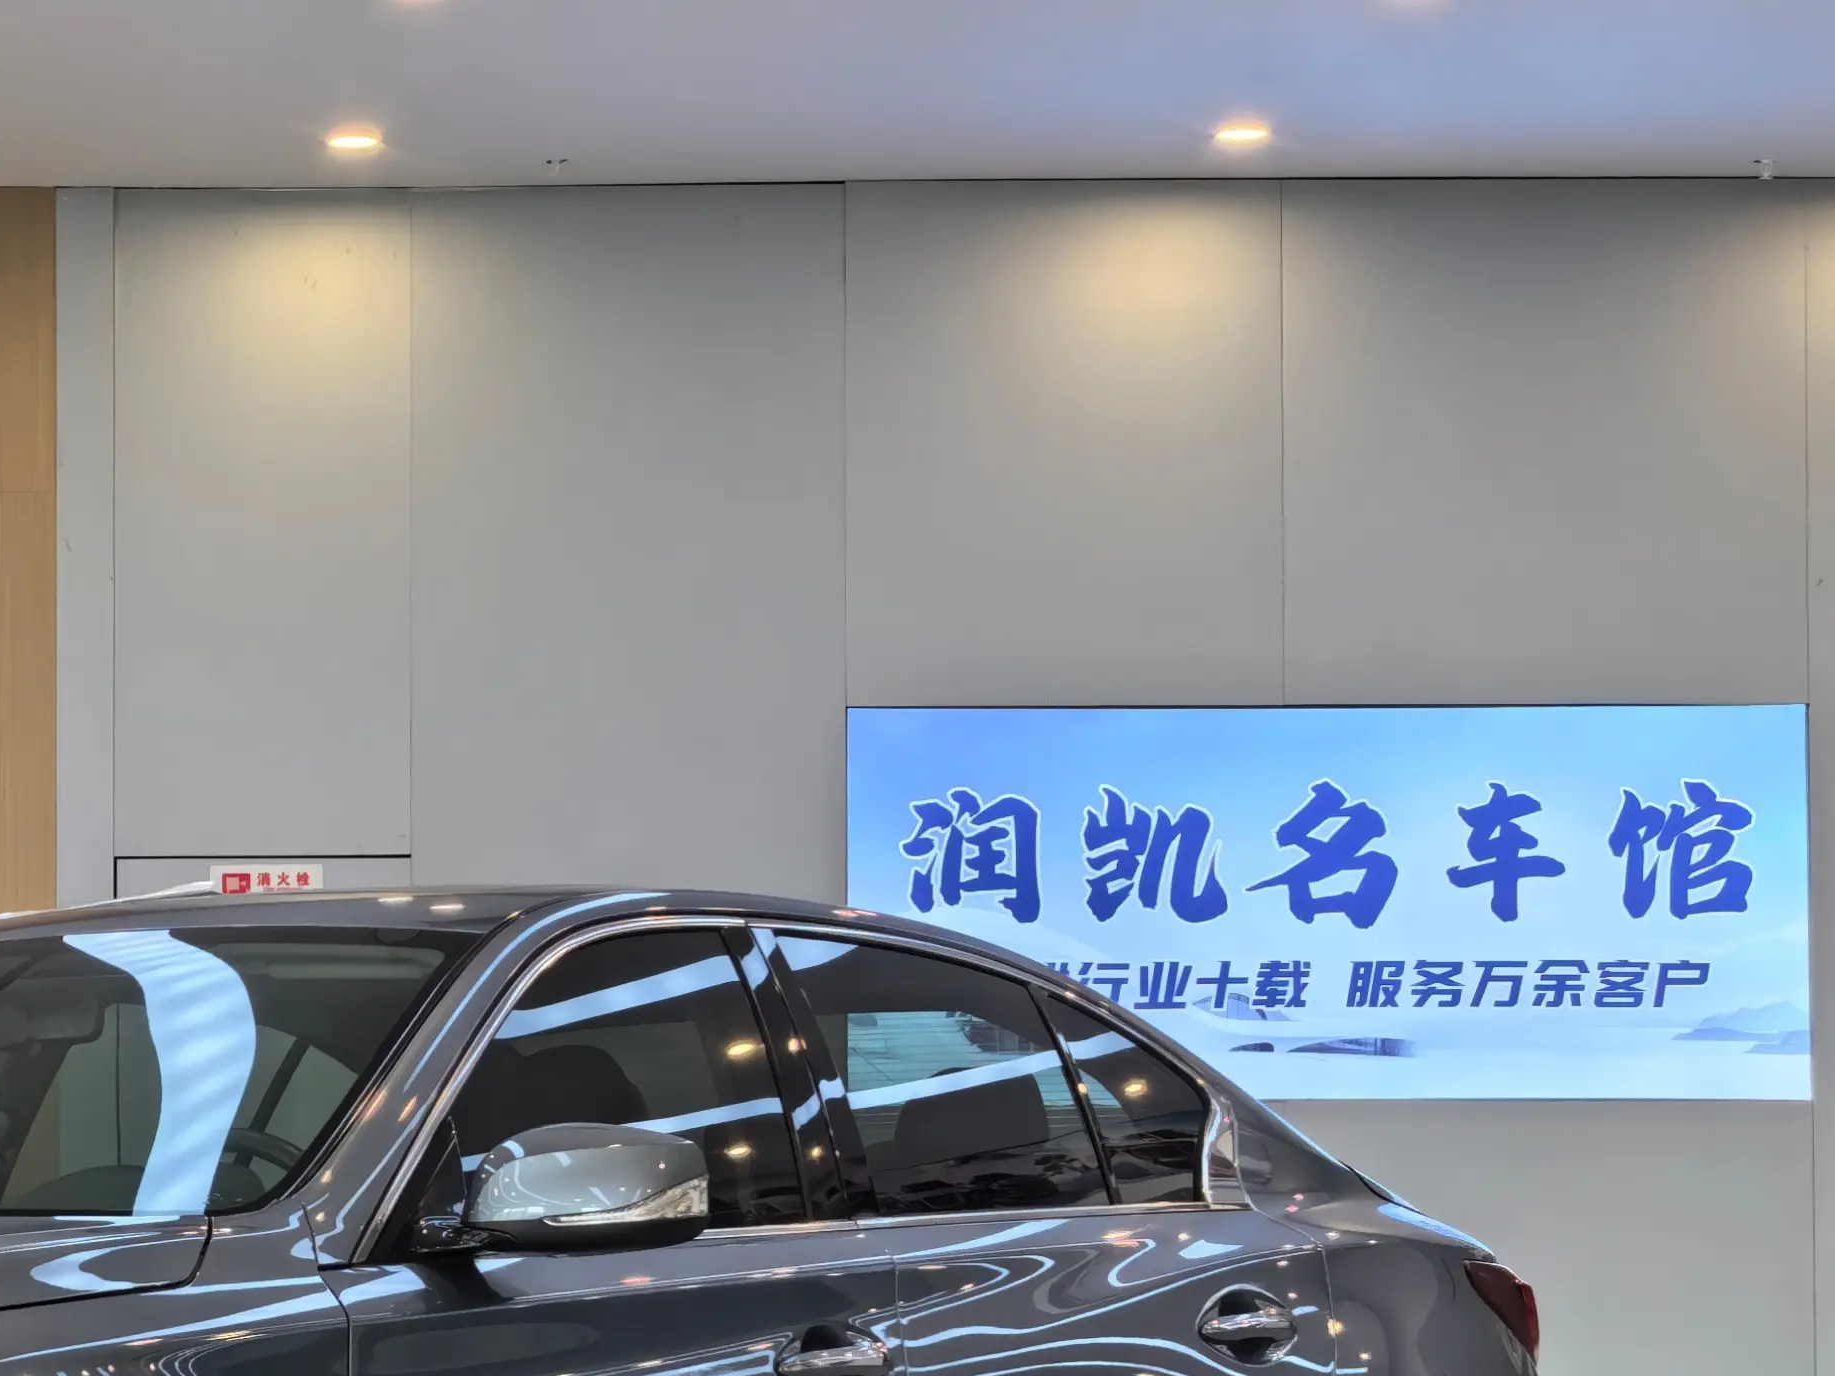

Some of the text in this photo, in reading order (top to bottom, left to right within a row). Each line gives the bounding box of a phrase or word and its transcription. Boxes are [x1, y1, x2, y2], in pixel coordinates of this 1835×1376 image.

[257, 872, 311, 886] 消火栓
[901, 779, 1755, 929] 润凯名车馆
[1046, 959, 1711, 1009] 行业十载 服务万余客户
